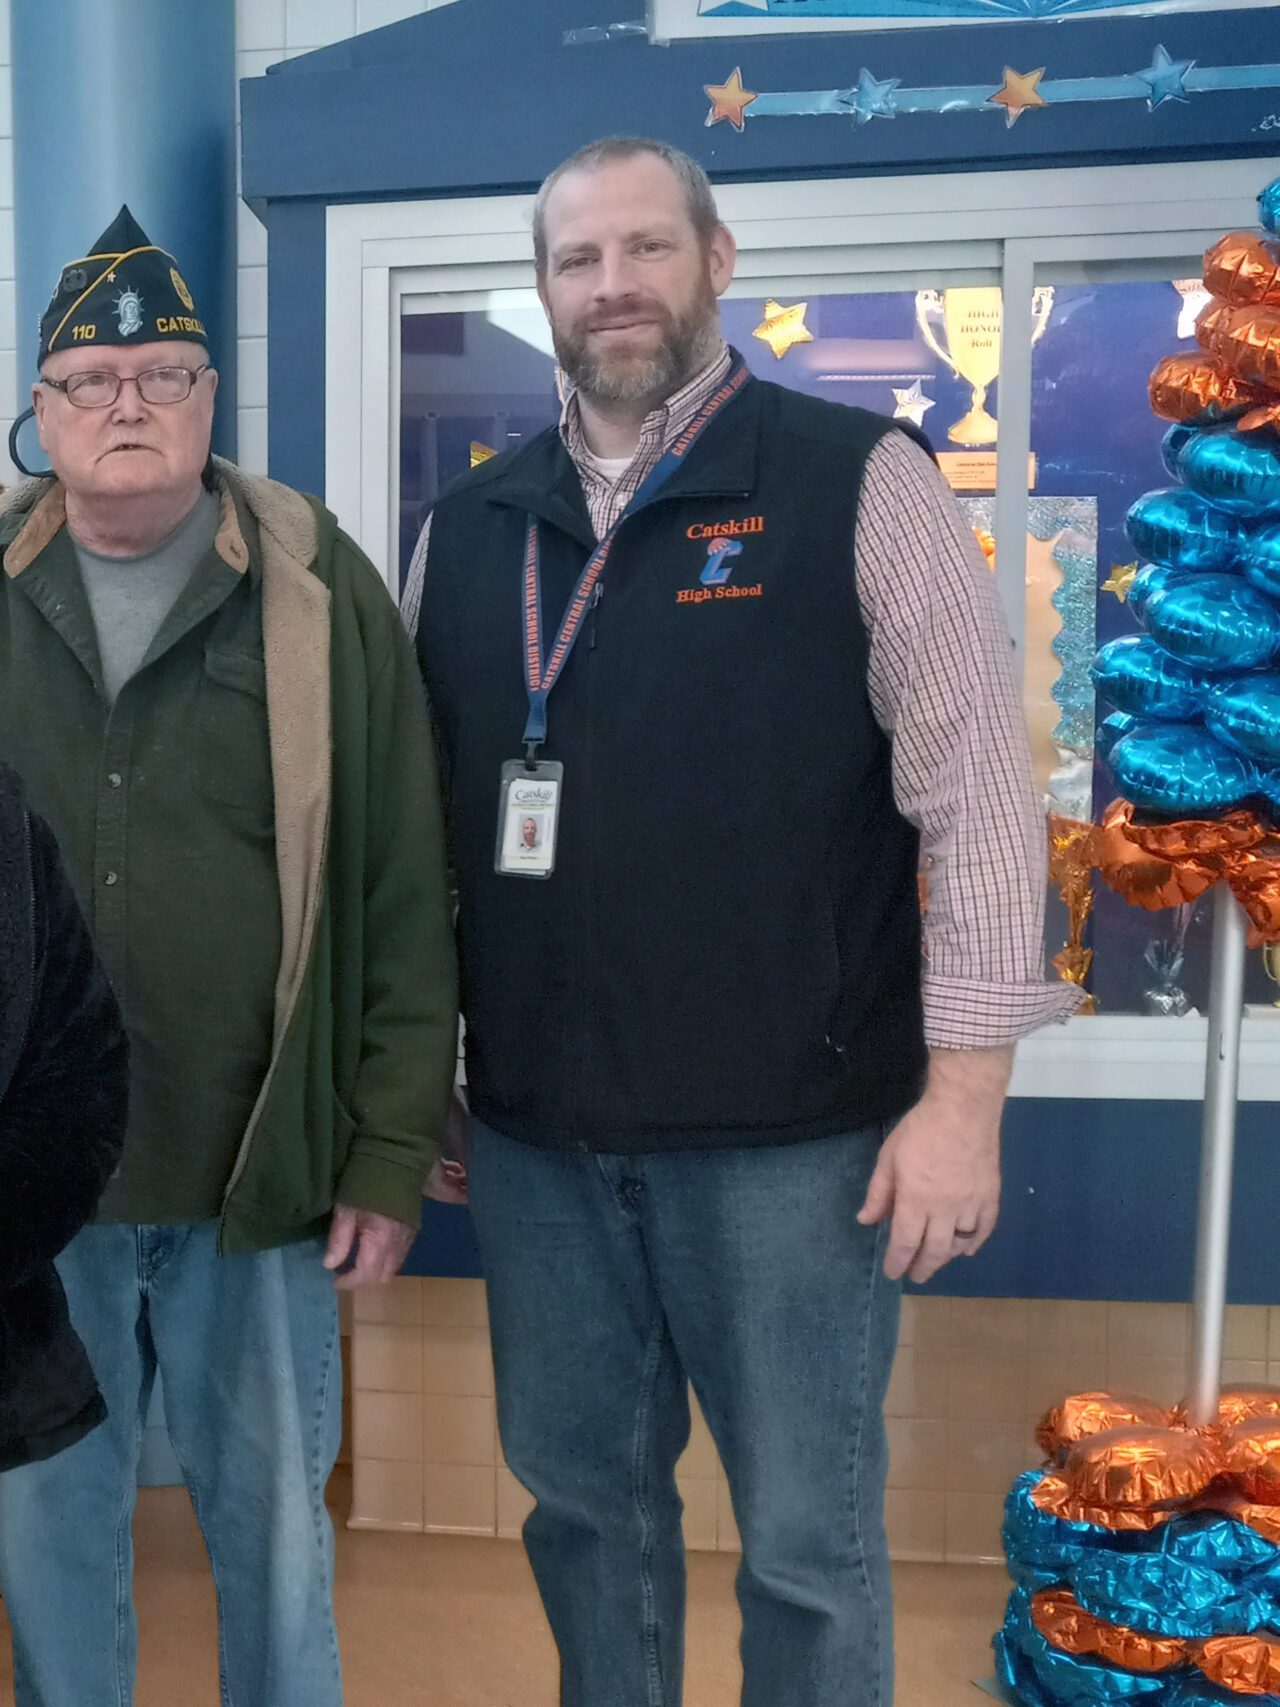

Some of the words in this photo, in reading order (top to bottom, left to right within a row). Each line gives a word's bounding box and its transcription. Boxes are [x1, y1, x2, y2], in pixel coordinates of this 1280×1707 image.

[71, 324, 97, 340] 110
[971, 338, 993, 348] Roll
[686, 516, 765, 539] Catskill
[525, 566, 537, 608] CENTRAL
[676, 588, 712, 604] High
[715, 583, 763, 599] School
[526, 607, 539, 645] SCHOOL
[541, 644, 569, 689] CATSKILL
[561, 599, 587, 643] CENTRAL
[576, 559, 606, 599] SCHOOL
[527, 646, 542, 691] DISTRICT
